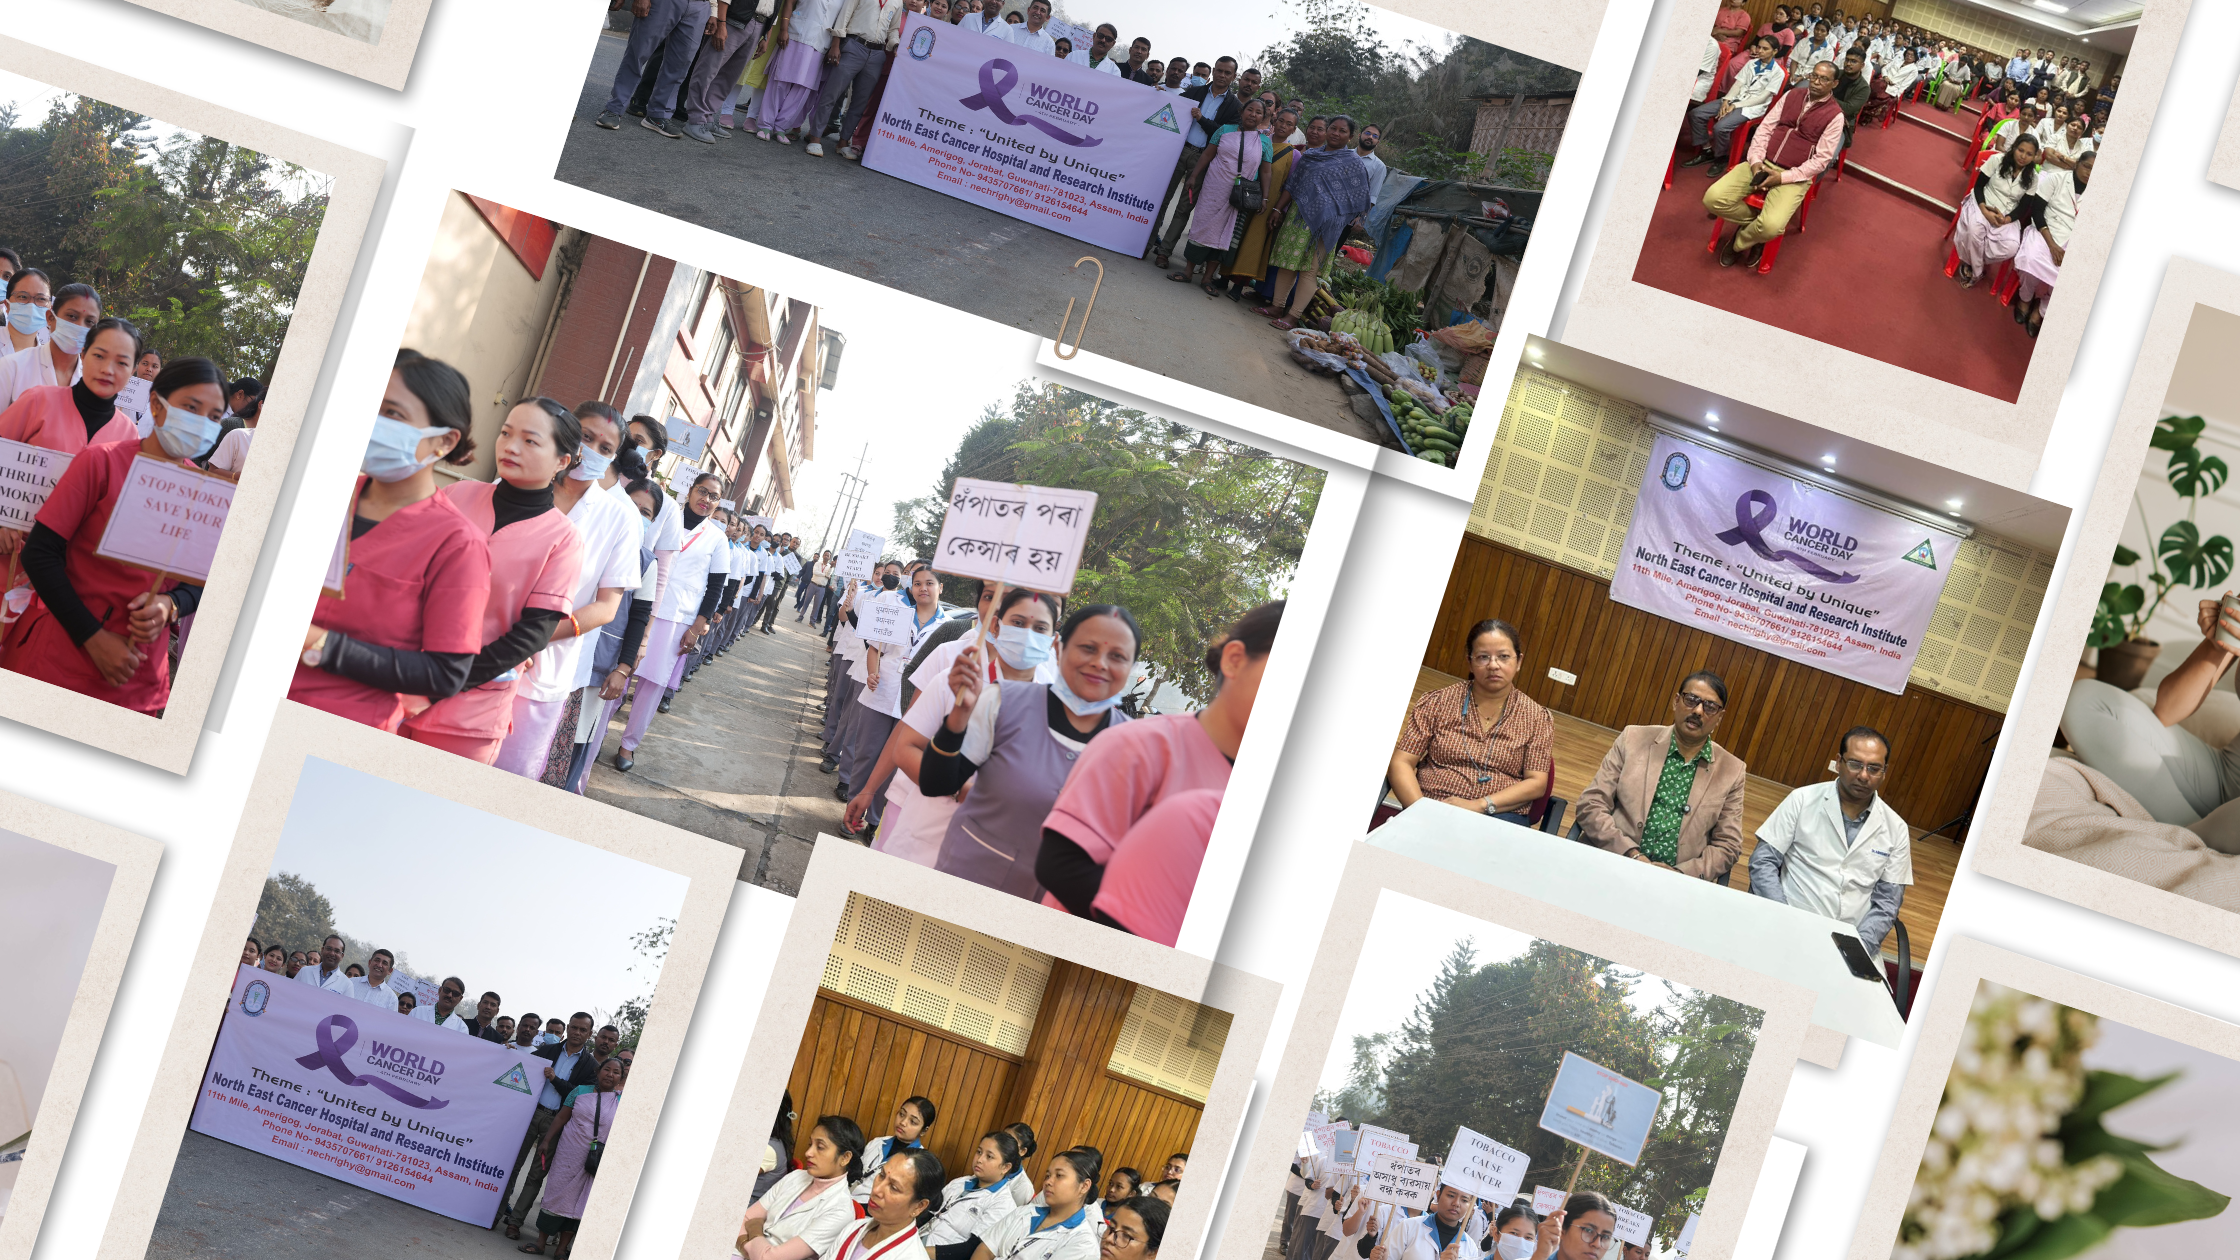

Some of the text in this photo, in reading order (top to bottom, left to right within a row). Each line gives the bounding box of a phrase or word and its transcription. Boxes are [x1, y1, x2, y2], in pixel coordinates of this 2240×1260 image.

[1026, 96, 1095, 124] CANCER DAY
[1030, 83, 1099, 116] WORLD
[918, 108, 966, 132] Theme
[1039, 148, 1058, 164] by
[877, 128, 894, 140] 11th
[897, 135, 918, 148] Mile,
[1089, 200, 1124, 218] Assam,
[1126, 212, 1149, 225] India
[881, 112, 1154, 212] North East Cancer Hospital and Research Institute
[937, 171, 962, 186] Email
[928, 157, 957, 172] Phone
[959, 167, 975, 178] No-
[1034, 193, 1088, 216] 9126154644
[17, 451, 48, 468] LIFE
[138, 474, 231, 510] STOP SMOKIN
[144, 498, 222, 528] SAVE YOUR
[160, 523, 192, 540] LIFE
[1784, 530, 1854, 561] CANCER DAY
[1788, 516, 1858, 552] WORLD
[1674, 542, 1722, 568] Theme
[1796, 585, 1816, 600] by
[1632, 563, 1650, 576] 11th
[1652, 570, 1674, 585] Mile,
[1844, 637, 1877, 654] Assam,
[1880, 646, 1902, 660] India
[1636, 546, 1908, 648] North East Cancer Hospital and Research Institute
[1694, 608, 1720, 622] Email
[1685, 594, 1714, 608] Phone
[1716, 604, 1732, 614] No-
[1790, 629, 1842, 652] 9126154644
[366, 1056, 441, 1086] CANCER DAY
[372, 1040, 445, 1076] WORLD
[252, 1067, 302, 1093] Theme
[381, 1110, 402, 1127] by
[208, 1090, 226, 1102] 11th
[229, 1096, 250, 1111] Mile,
[305, 1123, 343, 1143] Jorabat,
[435, 1166, 471, 1186] Assam,
[474, 1178, 498, 1192] India
[212, 1072, 504, 1179] North East Cancer Hospital and Research Institute
[262, 1120, 292, 1136] Phone
[296, 1131, 312, 1142] No-
[376, 1158, 434, 1184] 9126154644
[272, 1135, 300, 1150] Email
[307, 1148, 416, 1190] nechrighy@gmail.com
[1370, 1138, 1409, 1155] TOBACCO
[1470, 1138, 1516, 1164] TOBACCO
[1472, 1155, 1503, 1174] CAUSE
[1463, 1166, 1502, 1188] CANCER
